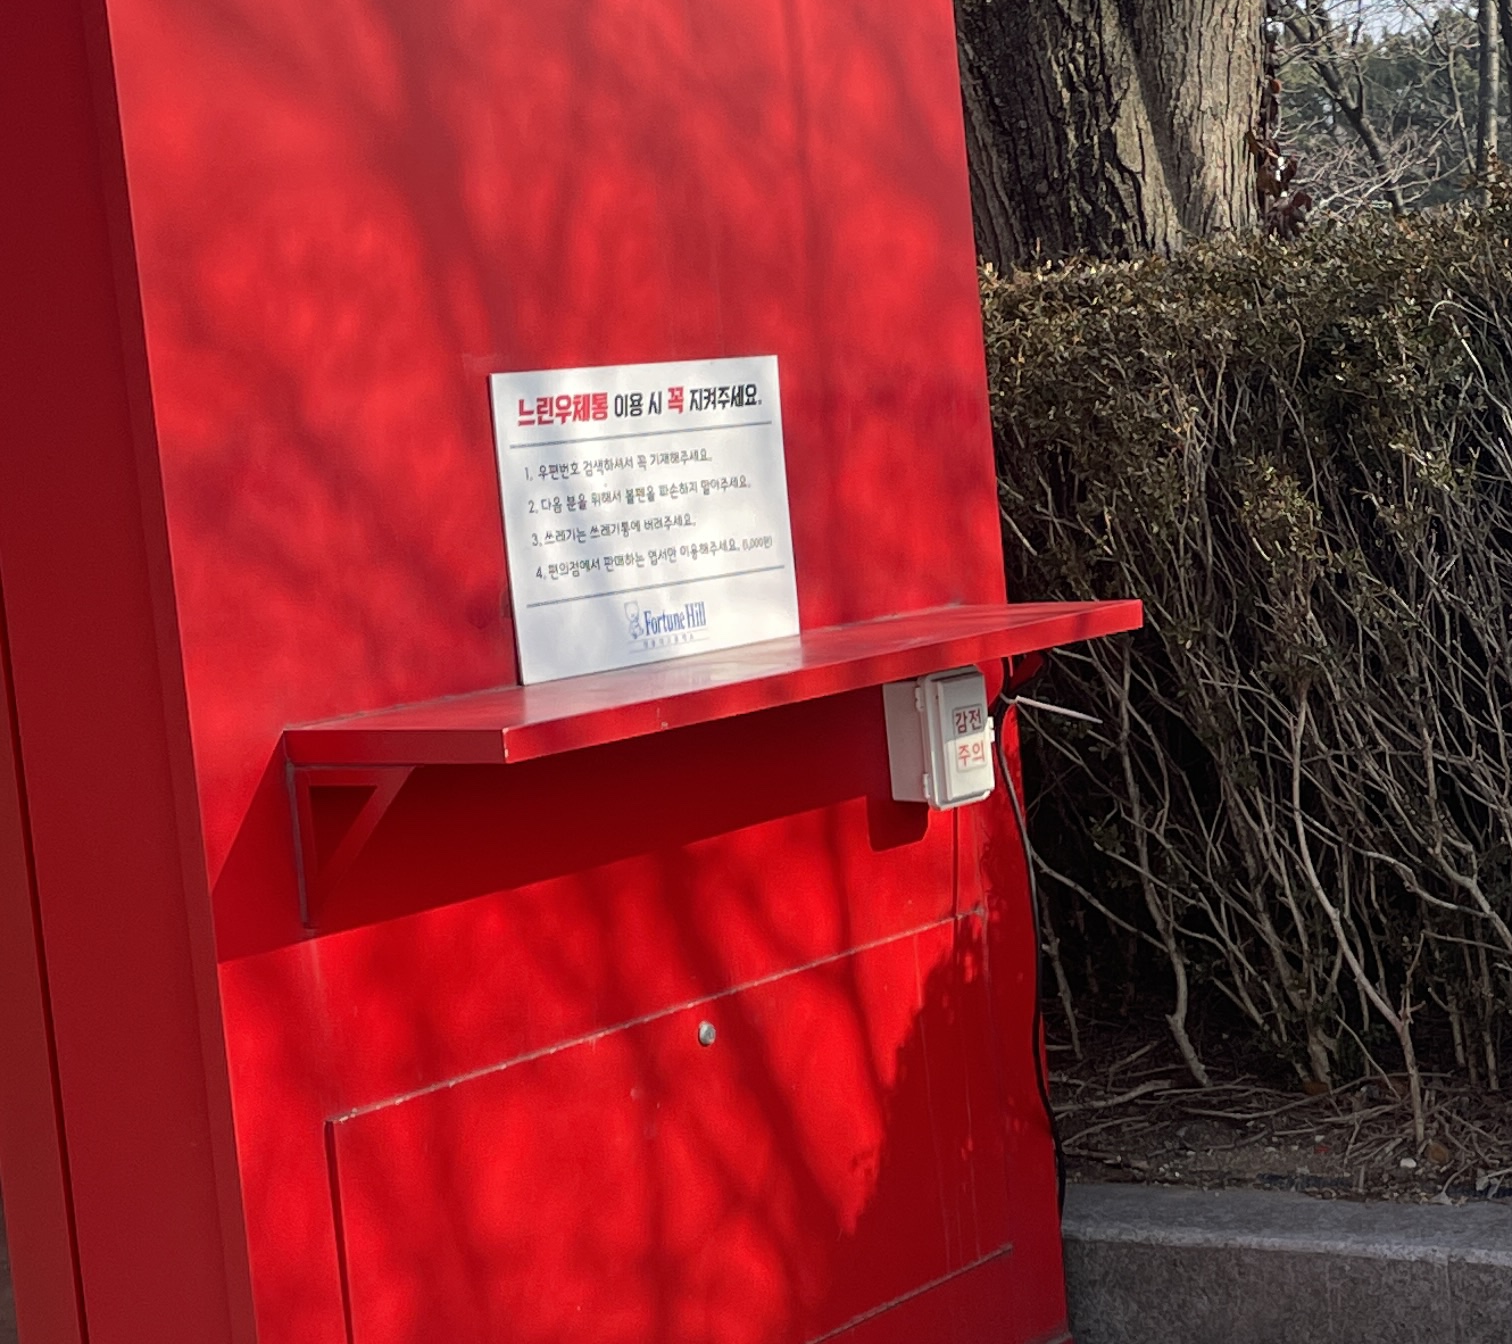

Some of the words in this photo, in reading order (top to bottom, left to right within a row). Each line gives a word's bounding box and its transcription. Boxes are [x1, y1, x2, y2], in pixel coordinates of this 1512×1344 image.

[518, 392, 608, 426] 느린우체통
[614, 392, 644, 418] 이용
[648, 390, 663, 415] 시
[667, 386, 684, 414] 꼭
[689, 383, 762, 411] 지켜주세요.
[524, 466, 534, 481] 1.
[538, 462, 580, 480] 우편번호
[528, 499, 538, 514] 2.
[540, 496, 562, 514] 다음
[532, 532, 542, 547] 3.
[544, 528, 587, 545] 쓰레기는
[590, 520, 641, 538] 쓰레기통에
[536, 566, 546, 580] 4.
[548, 557, 600, 580] 편의점에서
[603, 552, 645, 572] 판매하는
[643, 610, 686, 636] Fortune
[685, 601, 706, 629] Hill
[955, 708, 982, 734] 감전
[958, 740, 985, 767] 주의
